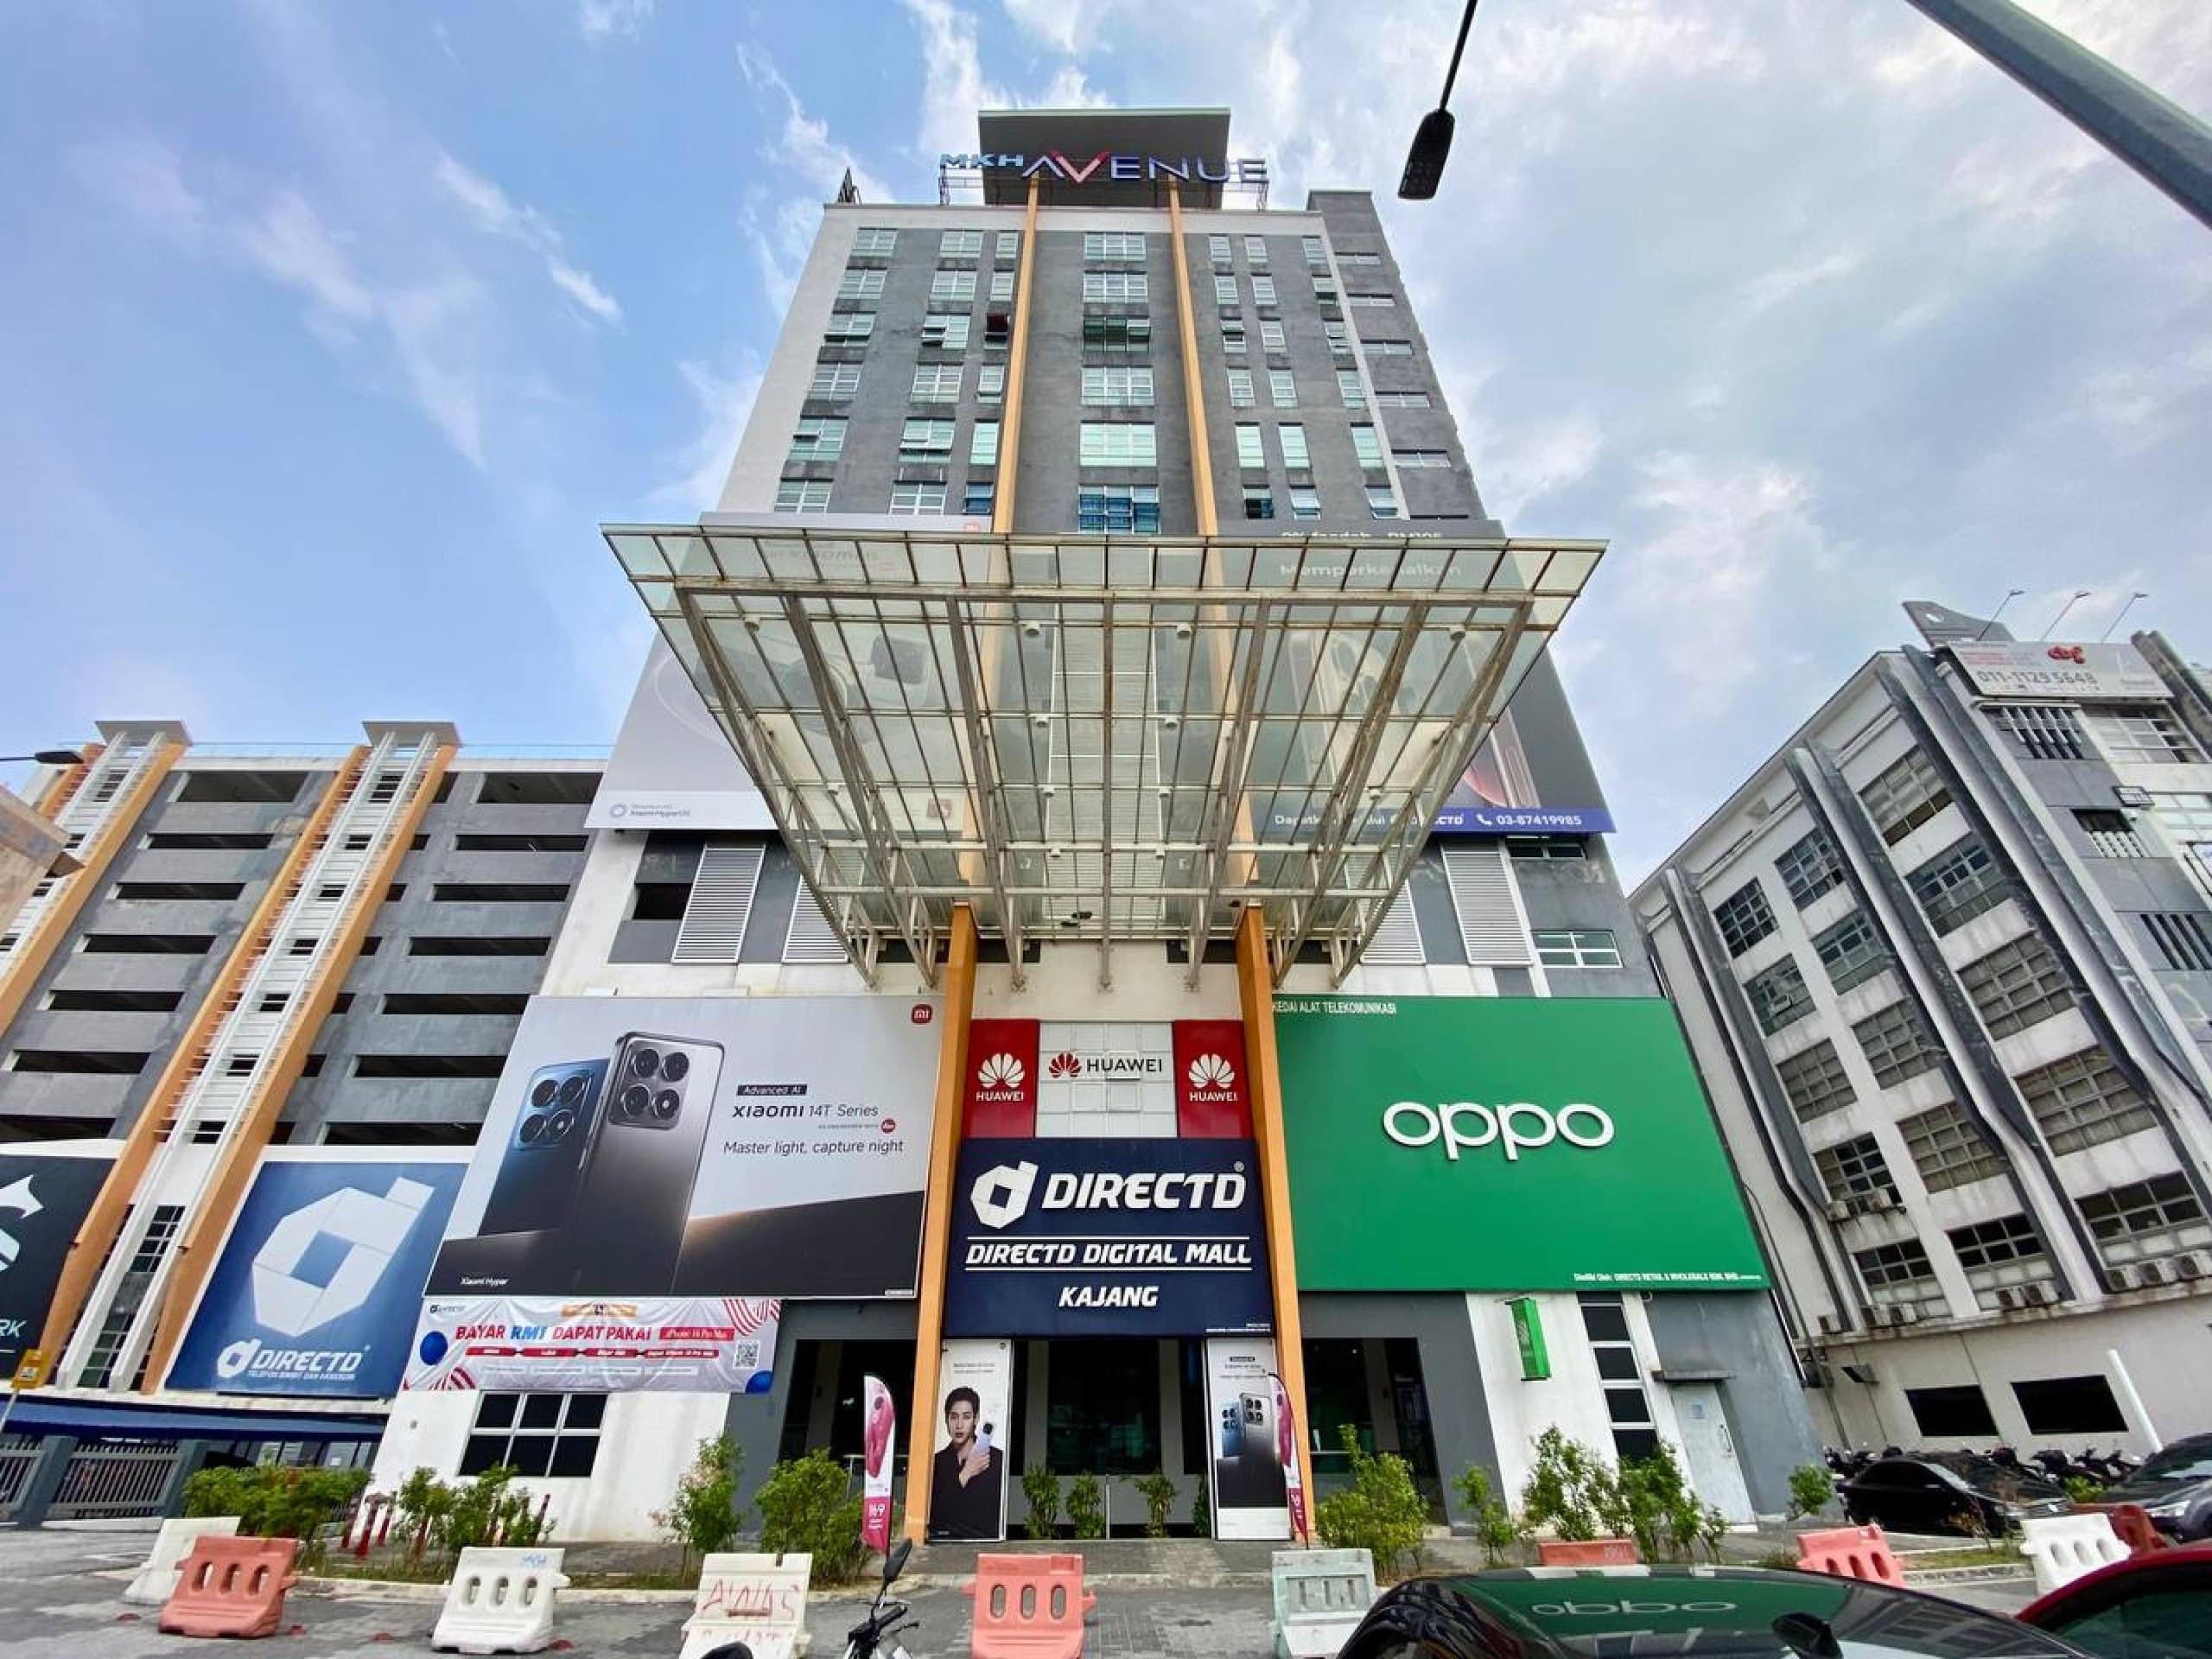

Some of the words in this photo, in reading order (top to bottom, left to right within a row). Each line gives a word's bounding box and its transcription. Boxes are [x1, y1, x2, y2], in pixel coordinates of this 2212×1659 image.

[939, 153, 1024, 168] MKH
[1021, 150, 1269, 184] AVENUE
[1086, 1057, 1163, 1073] HUAWEI
[744, 1085, 788, 1095] Advanced
[976, 1091, 1024, 1102] HUAWEI
[1189, 1091, 1237, 1102] HUAWEI
[733, 1105, 804, 1118] xiaomi
[809, 1105, 832, 1117] 14T
[837, 1104, 879, 1117] Series
[1382, 1102, 1615, 1160] oppo
[723, 1141, 771, 1154] Master
[812, 1142, 865, 1155] capture
[868, 1141, 905, 1154] night
[1041, 1173, 1247, 1210] DIRECTD
[966, 1243, 1077, 1264] DIRECTD
[1083, 1243, 1178, 1264] DIGITAL
[1185, 1243, 1252, 1264] MALL
[1058, 1286, 1160, 1307] KAJANG
[455, 1325, 505, 1339] BAYAR
[552, 1326, 604, 1340] DAPAT
[606, 1326, 652, 1340] PAKAI
[251, 1350, 363, 1372] DIRECTD
